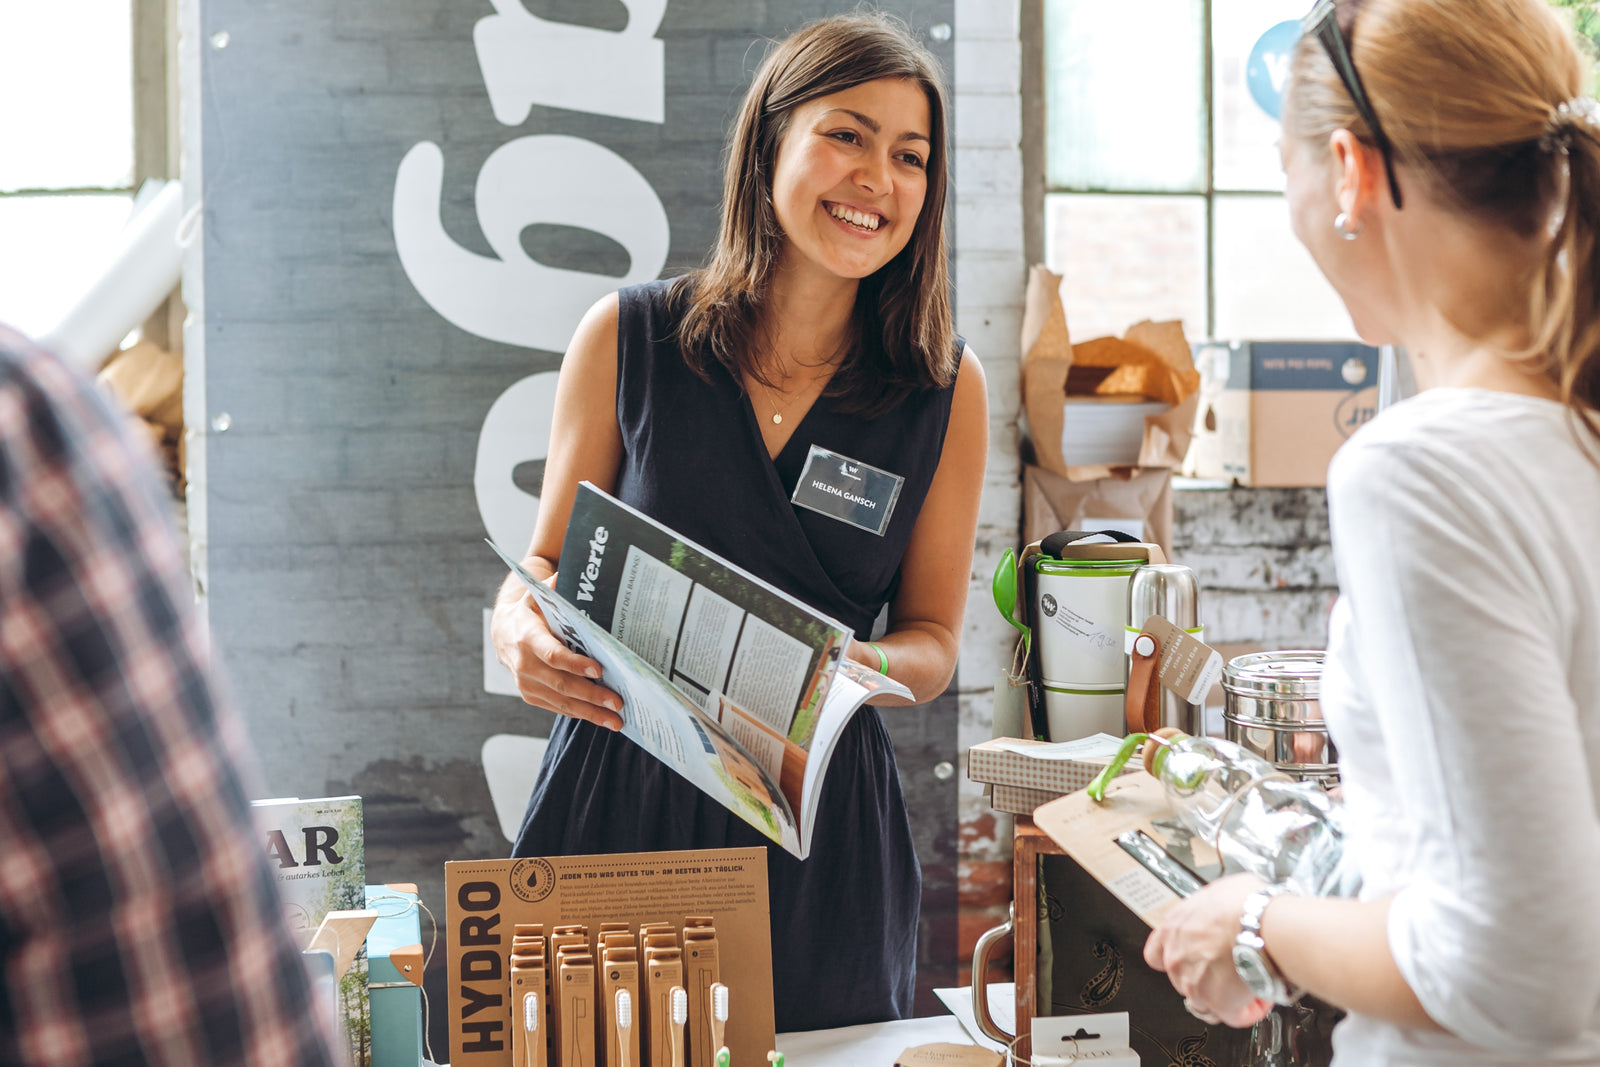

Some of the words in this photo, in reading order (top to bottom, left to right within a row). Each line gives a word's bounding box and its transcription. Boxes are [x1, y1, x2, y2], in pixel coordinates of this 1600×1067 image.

[812, 480, 842, 497] HELENA
[843, 492, 876, 509] GANSCH
[577, 526, 609, 601] Werte
[628, 554, 642, 585] BAUENS!
[624, 588, 633, 606] DES
[285, 871, 320, 881] autarkes
[322, 869, 345, 878] Leben
[675, 867, 701, 875] BESTEN
[458, 881, 504, 1053] HYDRO
